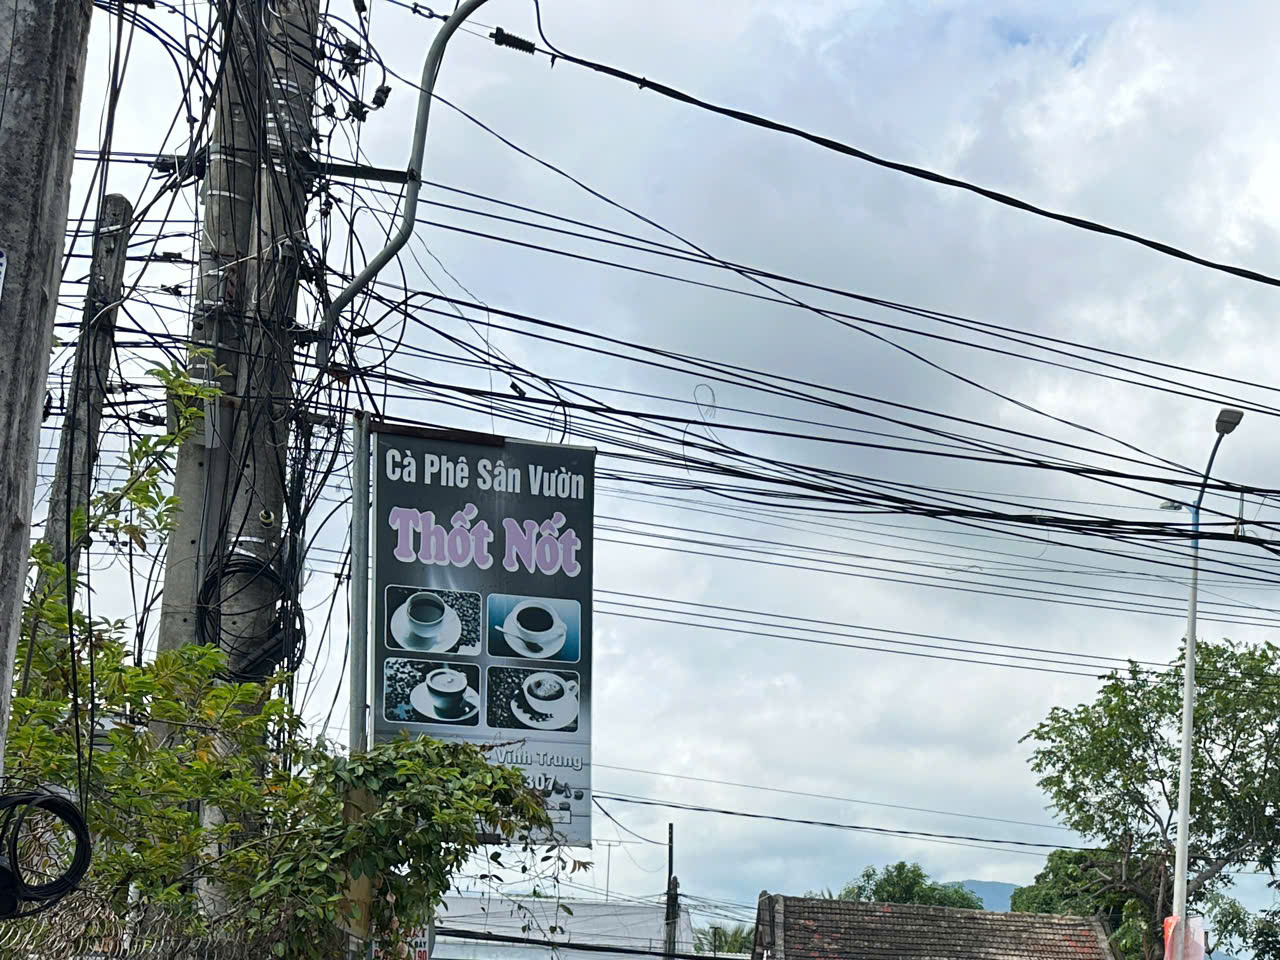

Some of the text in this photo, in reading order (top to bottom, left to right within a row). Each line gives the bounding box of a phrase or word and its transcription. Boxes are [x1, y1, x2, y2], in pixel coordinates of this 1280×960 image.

[386, 448, 585, 500] Cà Phê Sân Vườn
[389, 503, 581, 578] Thốt Nốt
[495, 746, 583, 772] Vĩnh Trung
